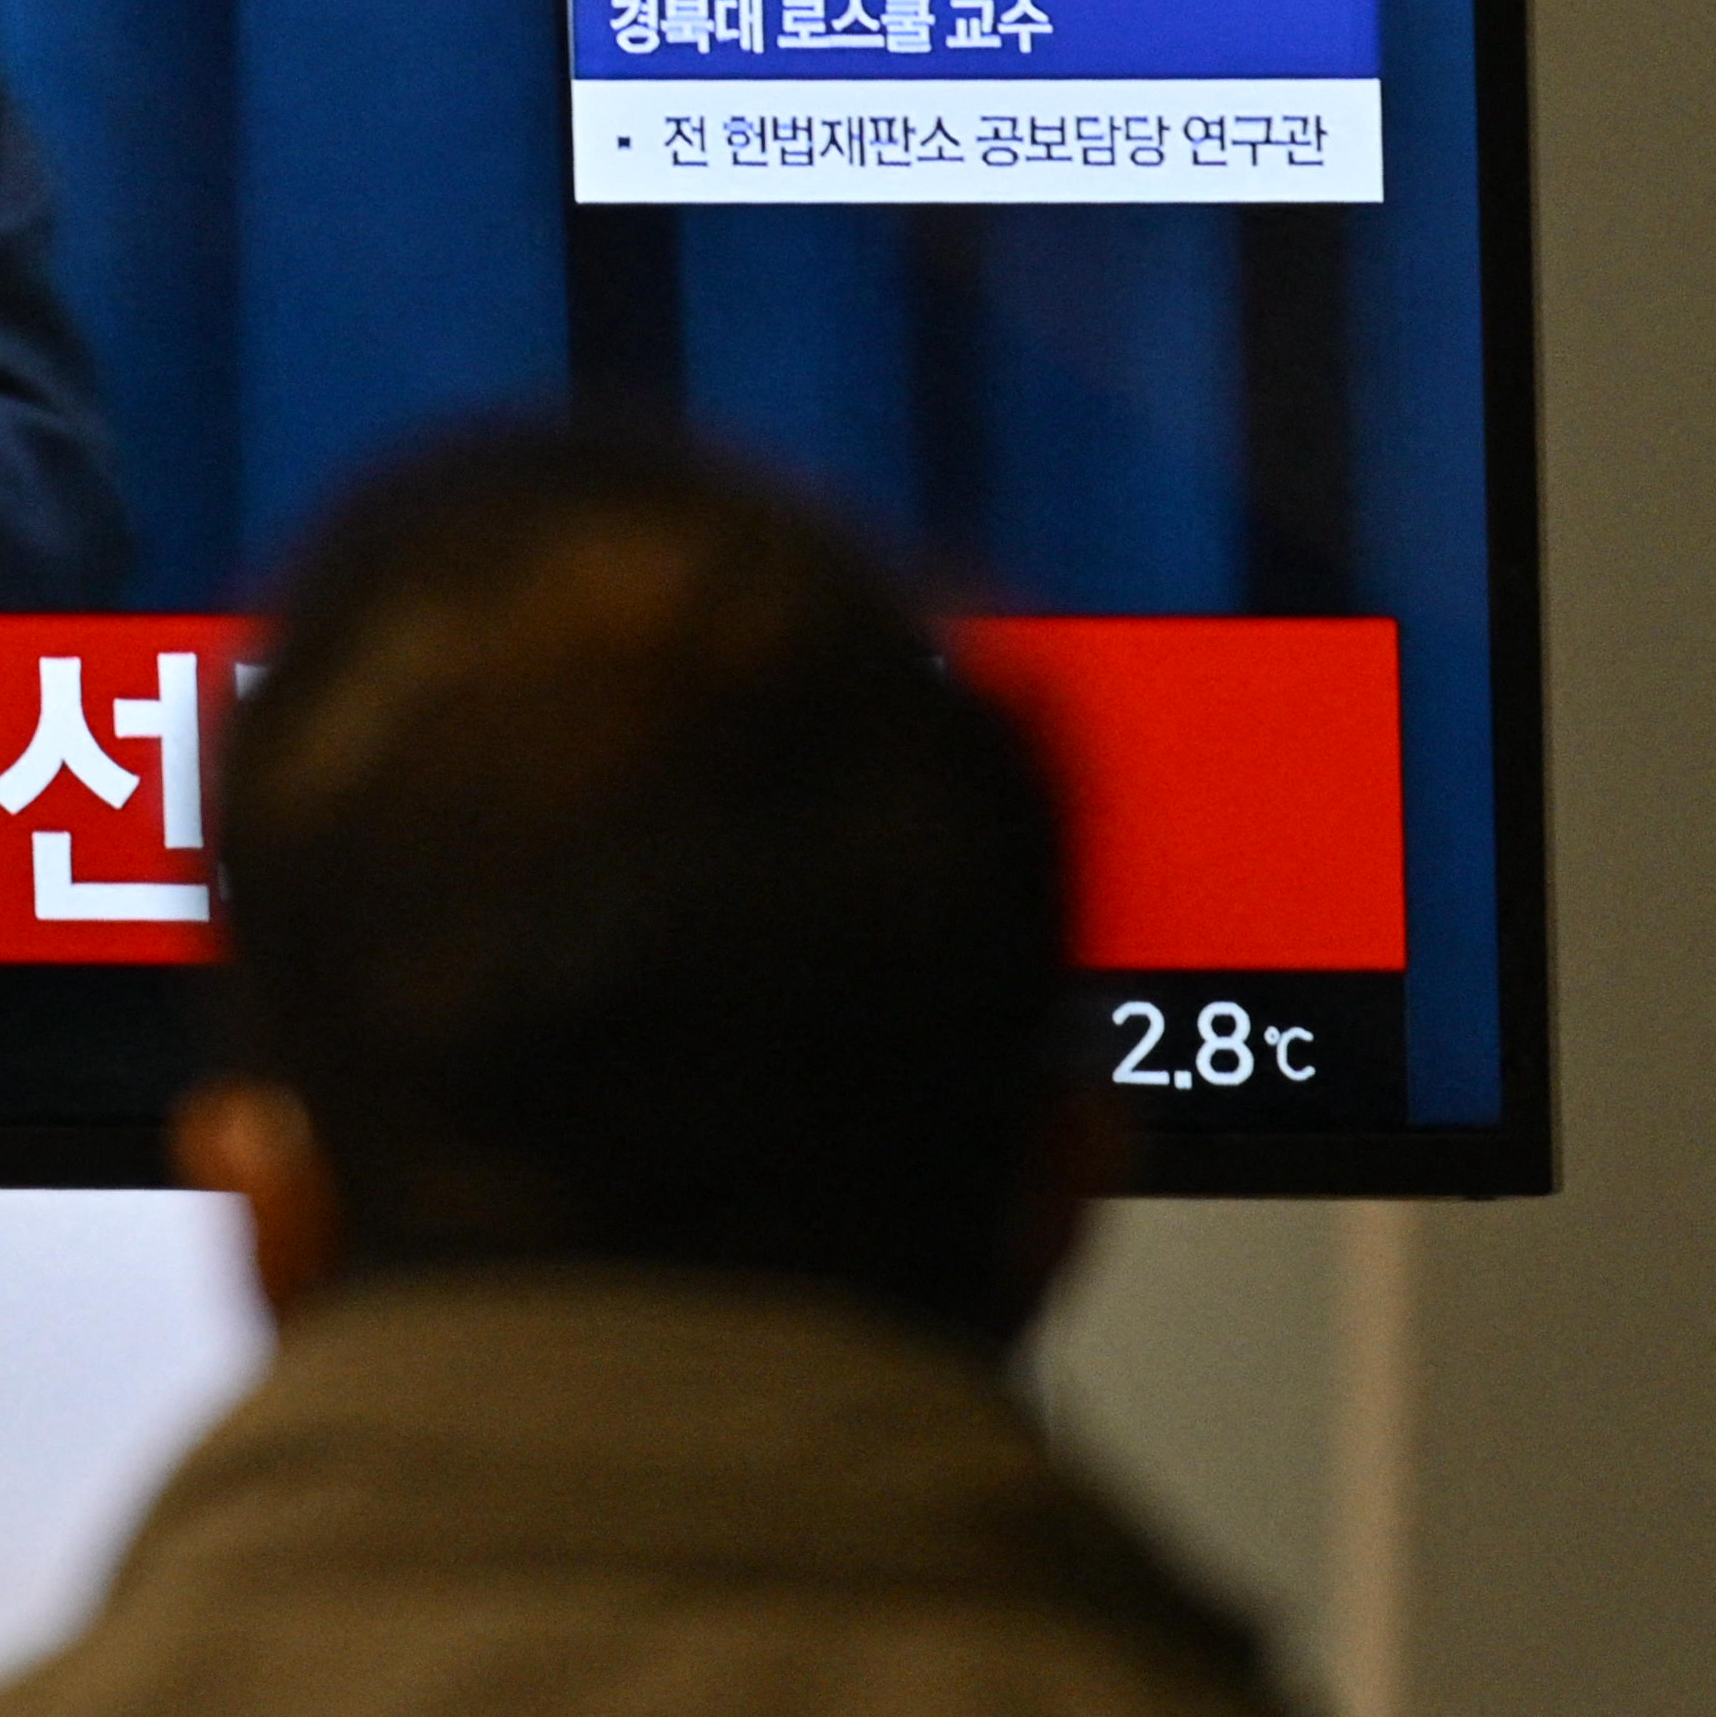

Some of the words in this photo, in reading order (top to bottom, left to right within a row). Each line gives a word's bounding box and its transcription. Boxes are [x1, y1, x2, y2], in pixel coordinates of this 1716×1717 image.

[663, 114, 709, 168] 전
[722, 114, 966, 168] 헌법재판소
[975, 114, 1172, 168] 공보담당
[1181, 113, 1329, 168] 연구관
